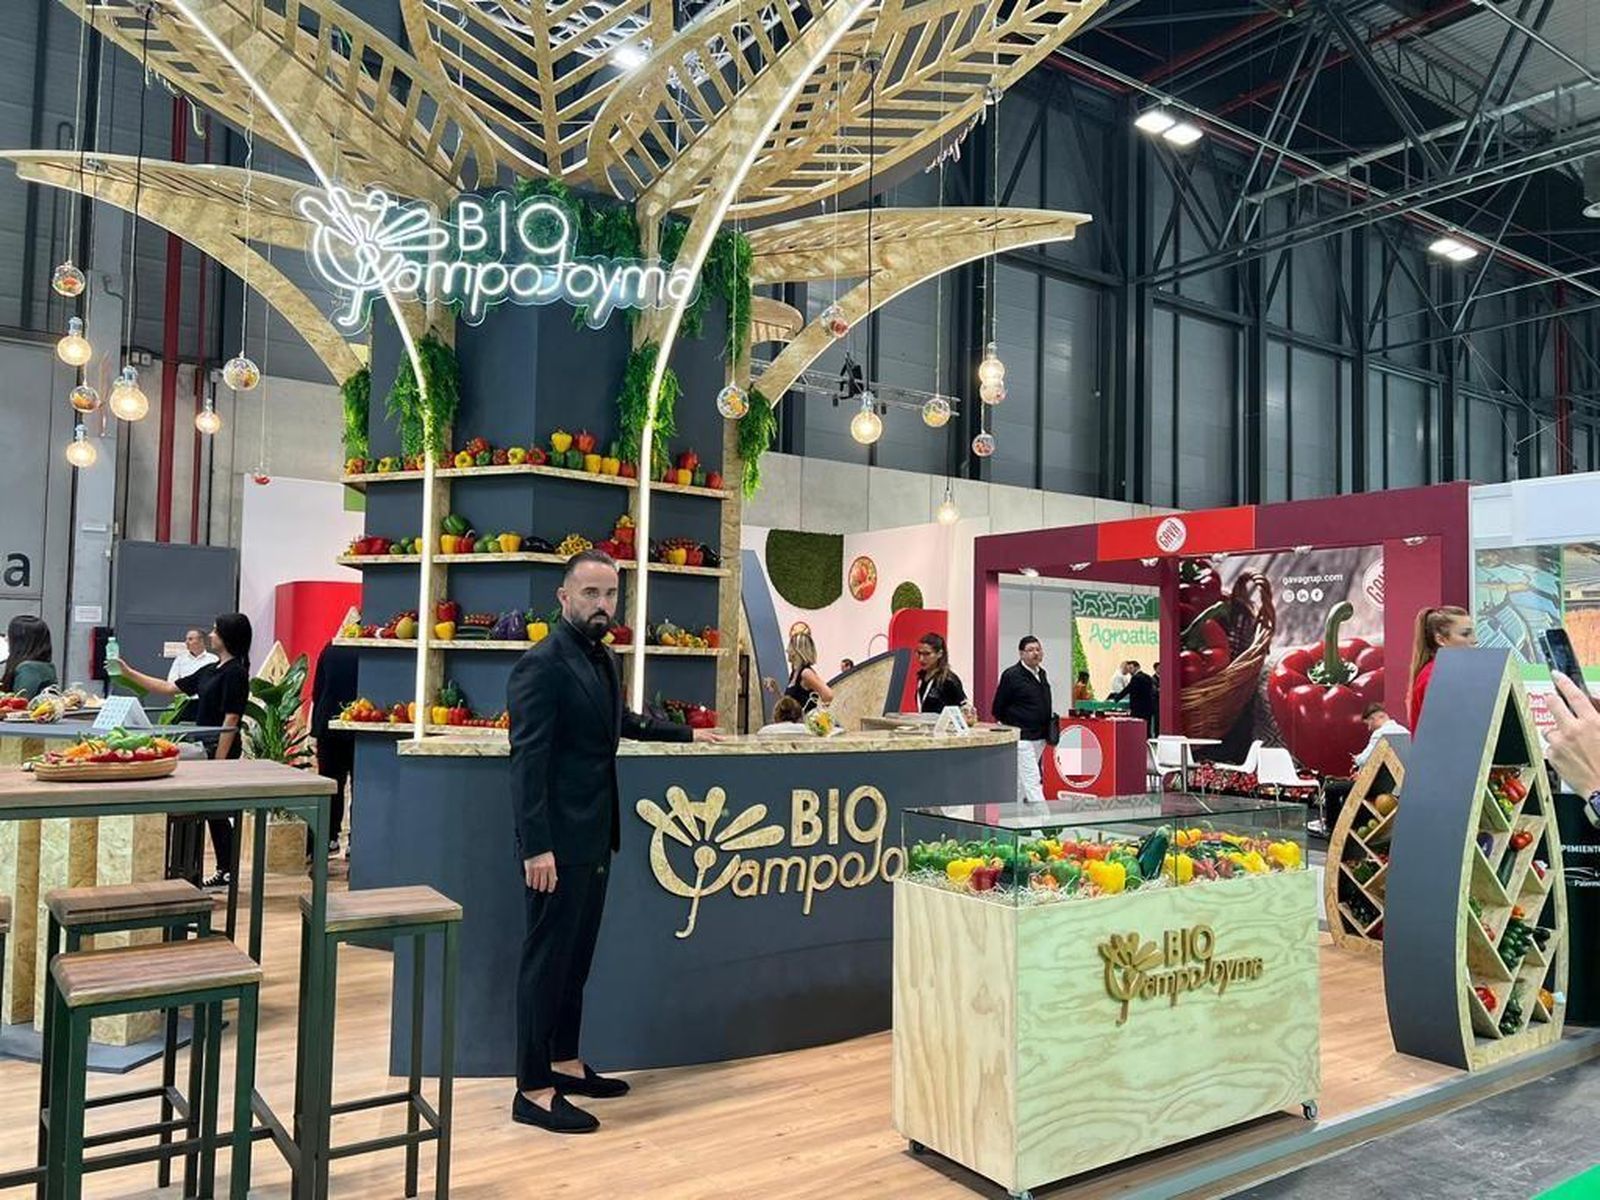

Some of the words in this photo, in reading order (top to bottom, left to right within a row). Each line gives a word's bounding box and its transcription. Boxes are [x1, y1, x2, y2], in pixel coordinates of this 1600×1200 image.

[458, 201, 569, 255] BIO
[3, 552, 31, 588] a
[1282, 573, 1344, 586] gavagrup.com
[1089, 622, 1158, 650] Agroatla
[790, 784, 888, 847] BIO
[1559, 844, 1600, 853] PIMIENT
[1164, 924, 1216, 967] BIO
